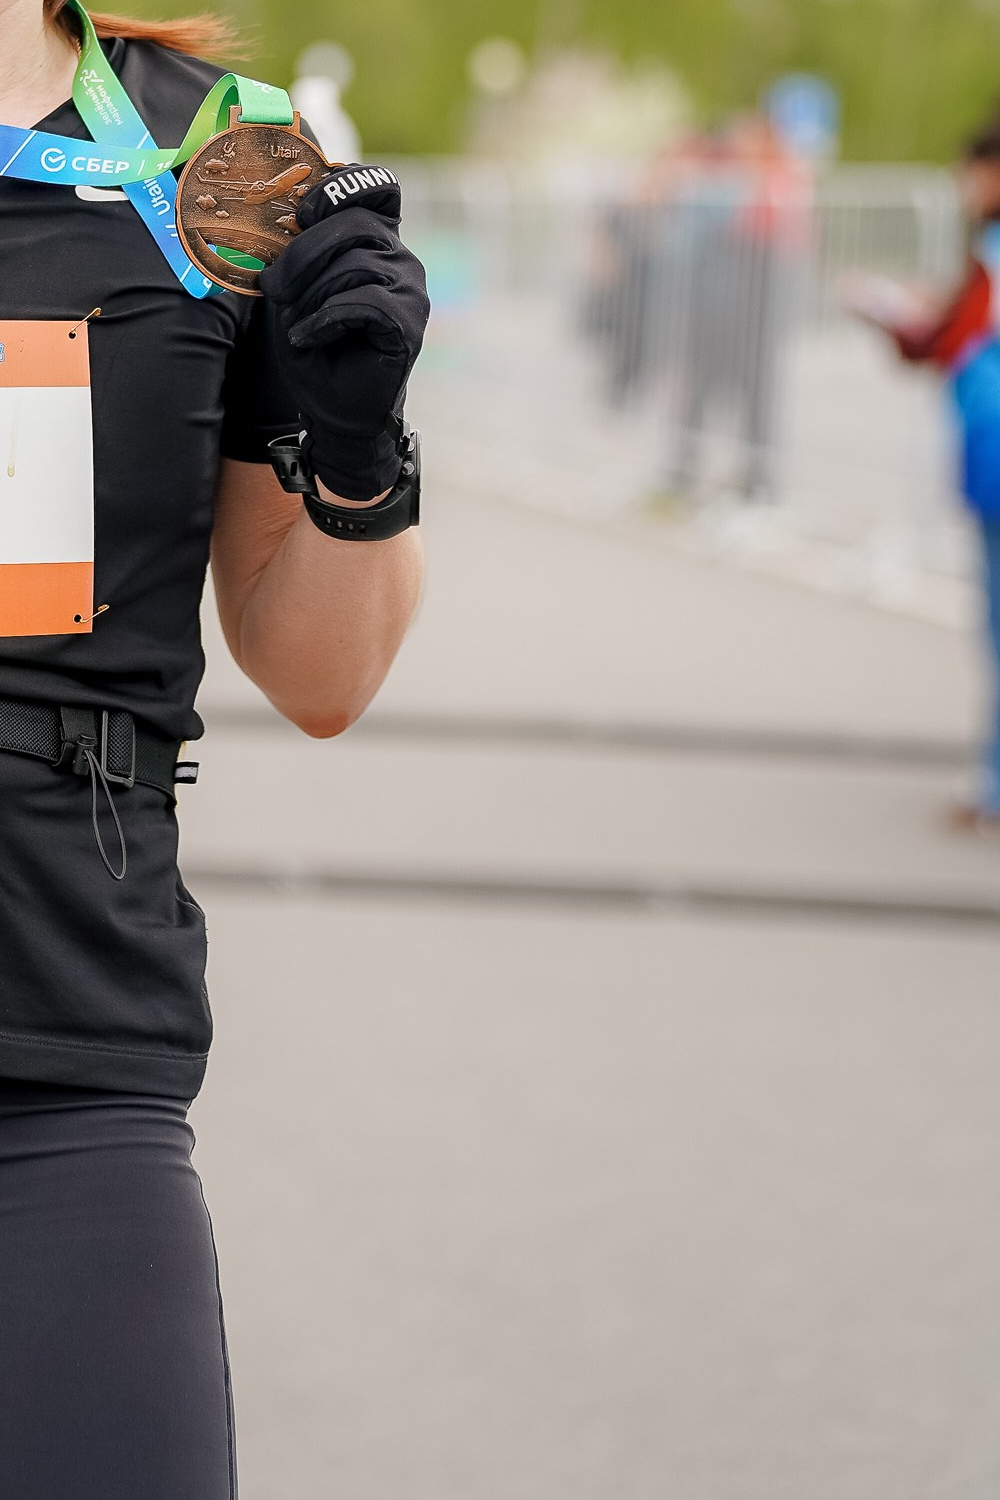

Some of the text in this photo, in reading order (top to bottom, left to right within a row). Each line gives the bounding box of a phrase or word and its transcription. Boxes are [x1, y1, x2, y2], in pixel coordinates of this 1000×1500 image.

[270, 145, 301, 159] Utair
[71, 156, 130, 175] СБЕР
[323, 167, 401, 206] RUNNI
